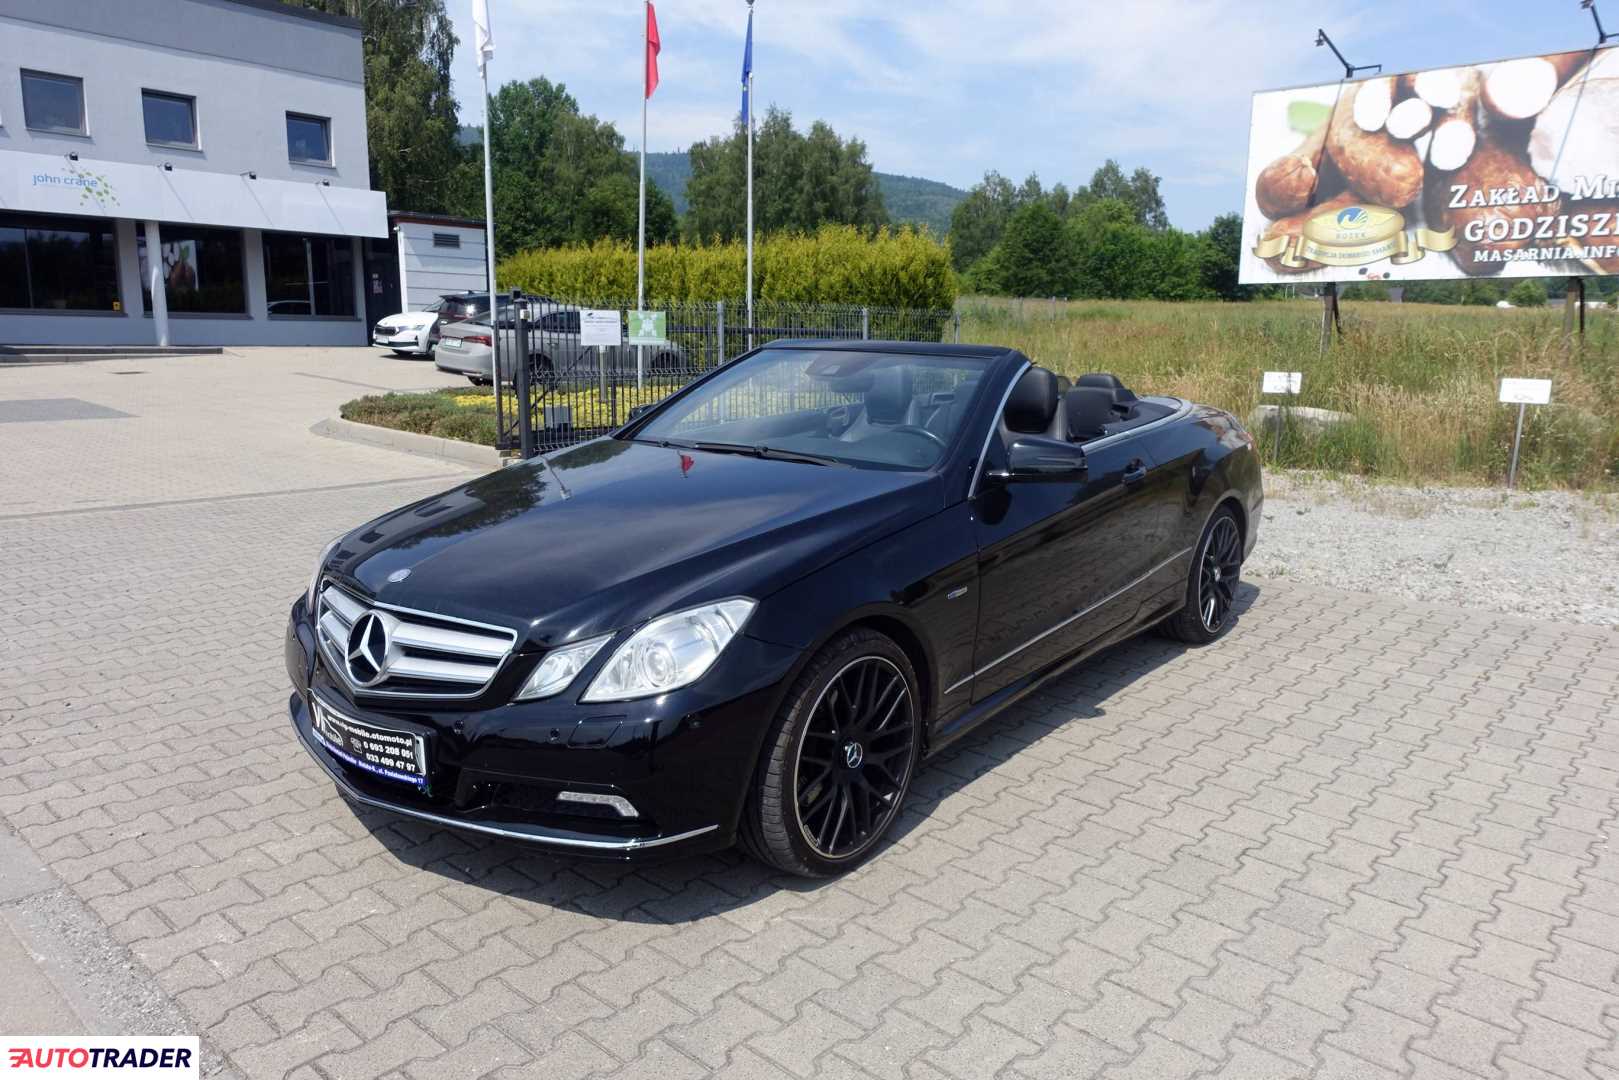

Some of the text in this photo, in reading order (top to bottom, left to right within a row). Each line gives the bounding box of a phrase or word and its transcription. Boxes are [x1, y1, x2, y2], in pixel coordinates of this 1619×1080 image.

[32, 174, 98, 187] john crane
[1571, 175, 1619, 201] MI
